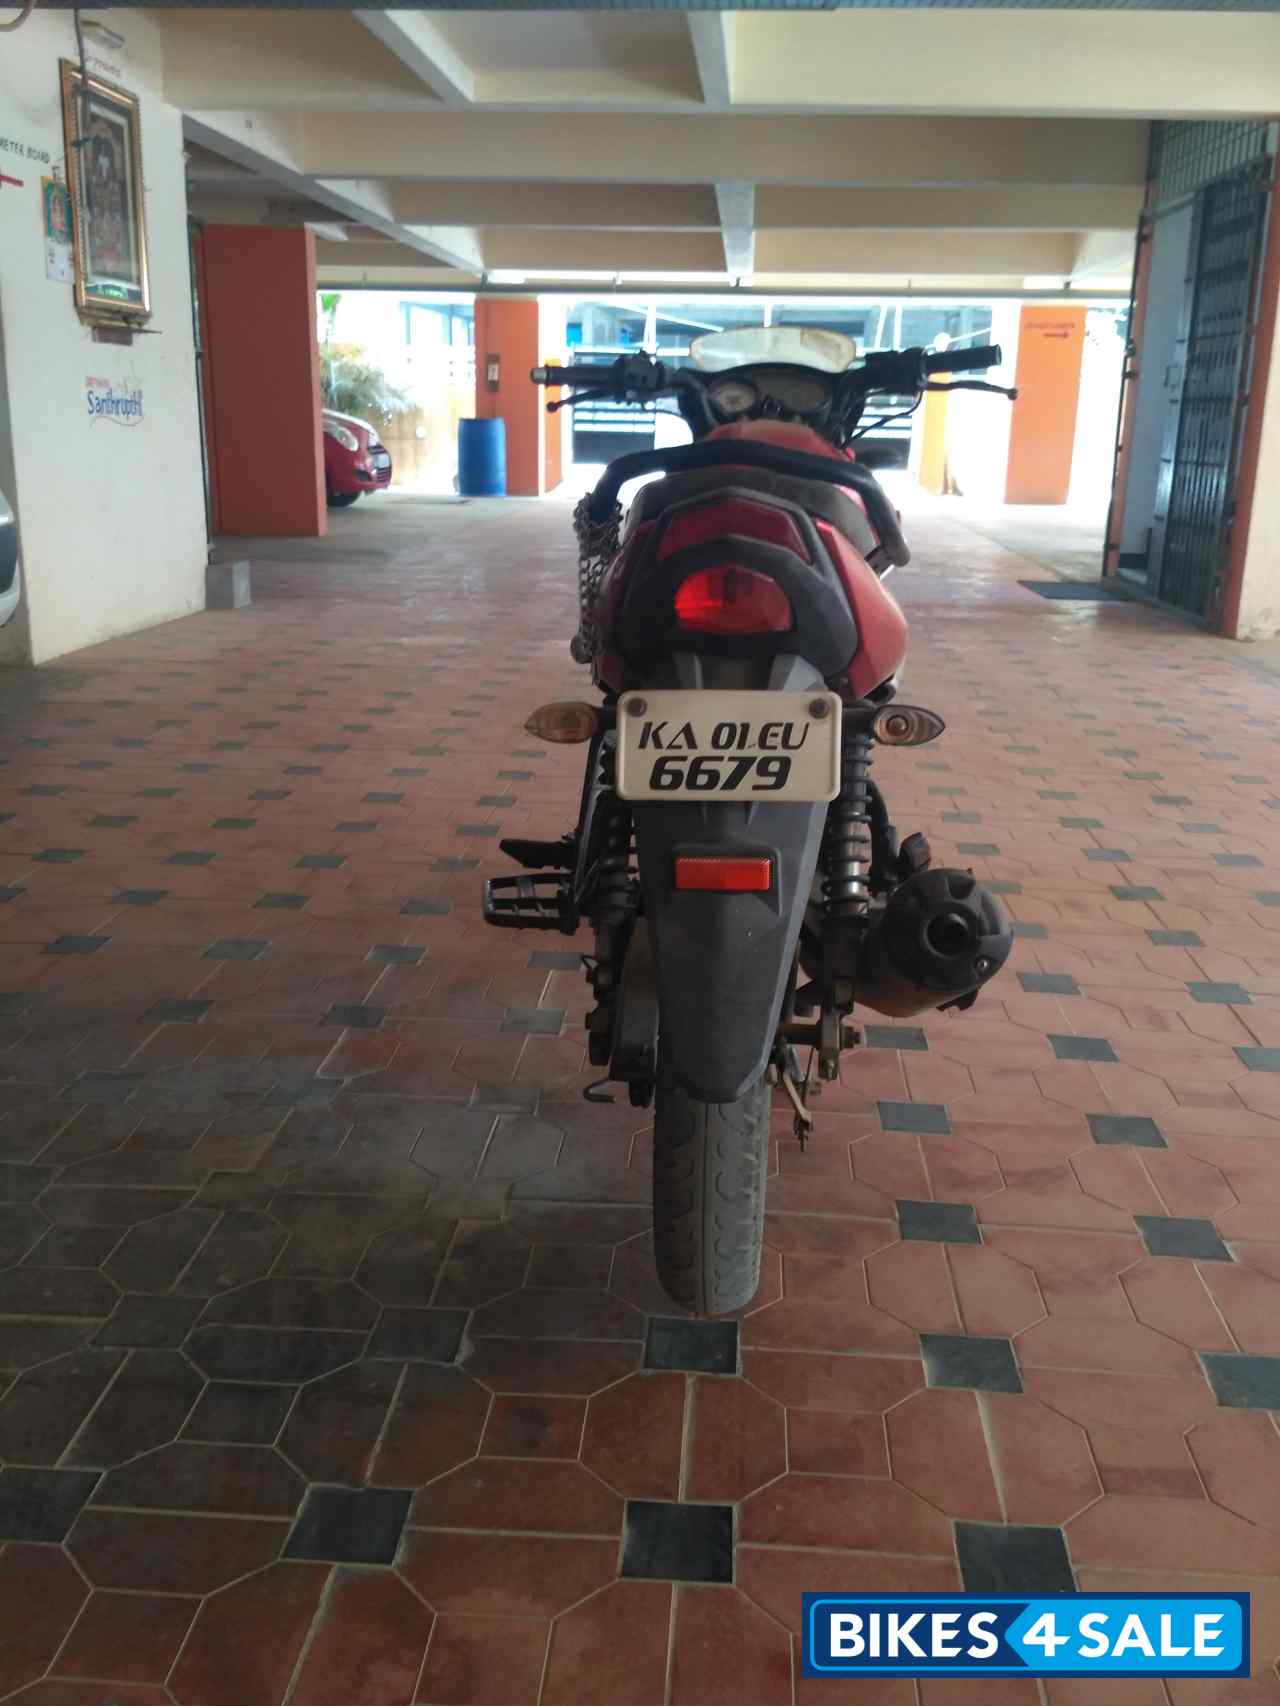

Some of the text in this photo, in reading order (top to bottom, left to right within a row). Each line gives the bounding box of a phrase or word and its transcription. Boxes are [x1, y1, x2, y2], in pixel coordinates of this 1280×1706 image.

[27, 143, 50, 165] BOARD
[638, 721, 698, 750] KA
[649, 755, 792, 791] 6679
